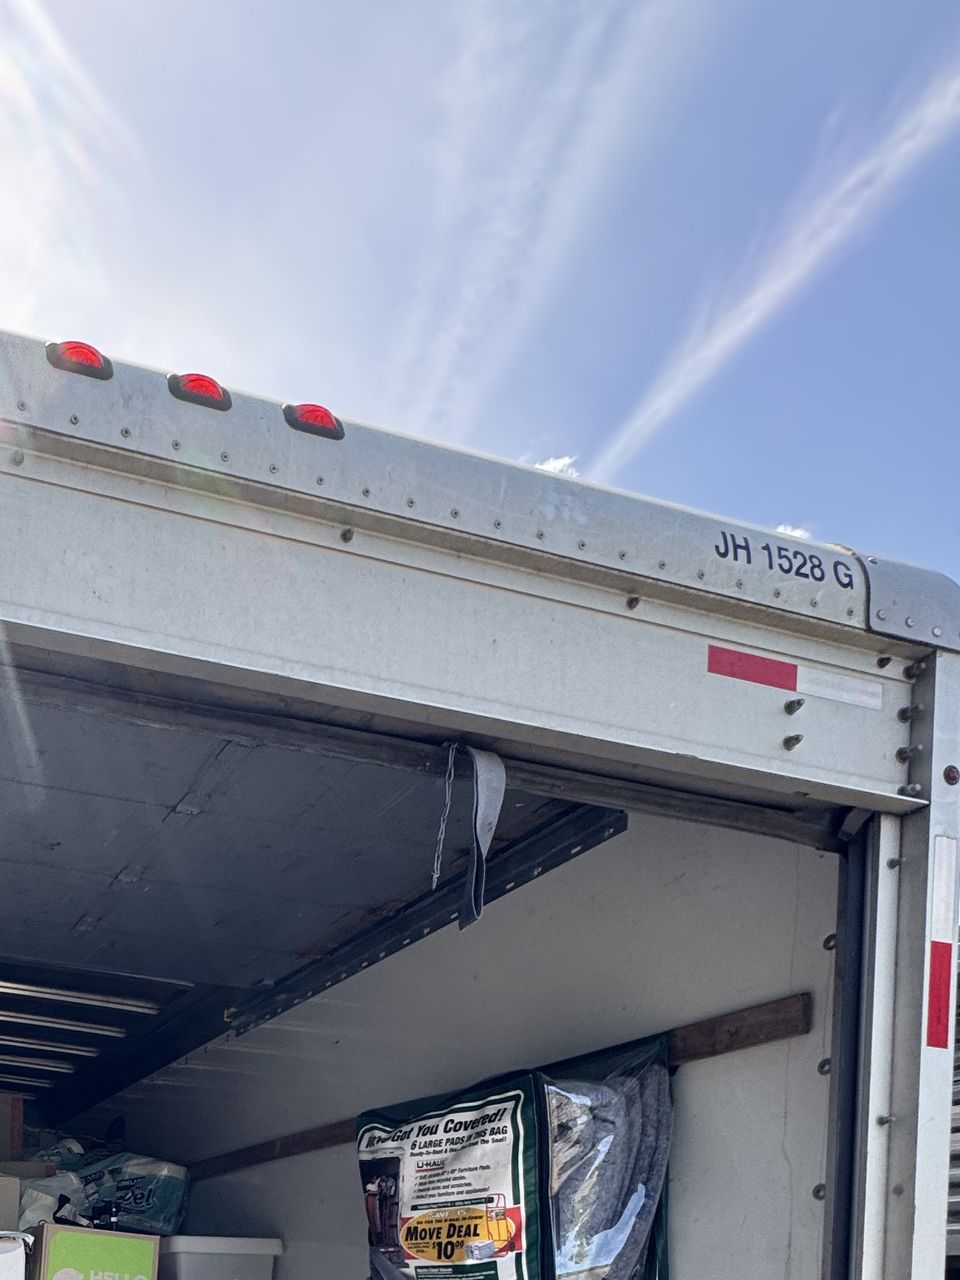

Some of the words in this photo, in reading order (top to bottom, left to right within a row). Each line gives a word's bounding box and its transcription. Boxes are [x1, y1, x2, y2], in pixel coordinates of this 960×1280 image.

[715, 531, 751, 564] JH
[761, 543, 825, 582] 1528
[833, 560, 854, 590] G
[391, 1126, 414, 1143] Got
[416, 1123, 440, 1138] You
[443, 1108, 508, 1134] Covered!
[410, 1140, 417, 1150] 6
[418, 1138, 442, 1150] LARGE
[444, 1136, 464, 1147] PADS
[488, 1126, 508, 1137] BAG
[410, 1148, 444, 1158] Ready-To-Rent
[416, 1159, 446, 1168] U-HAUL
[457, 1165, 478, 1174] Furniture
[405, 1226, 442, 1242] MOVE
[446, 1223, 480, 1240] DEAL
